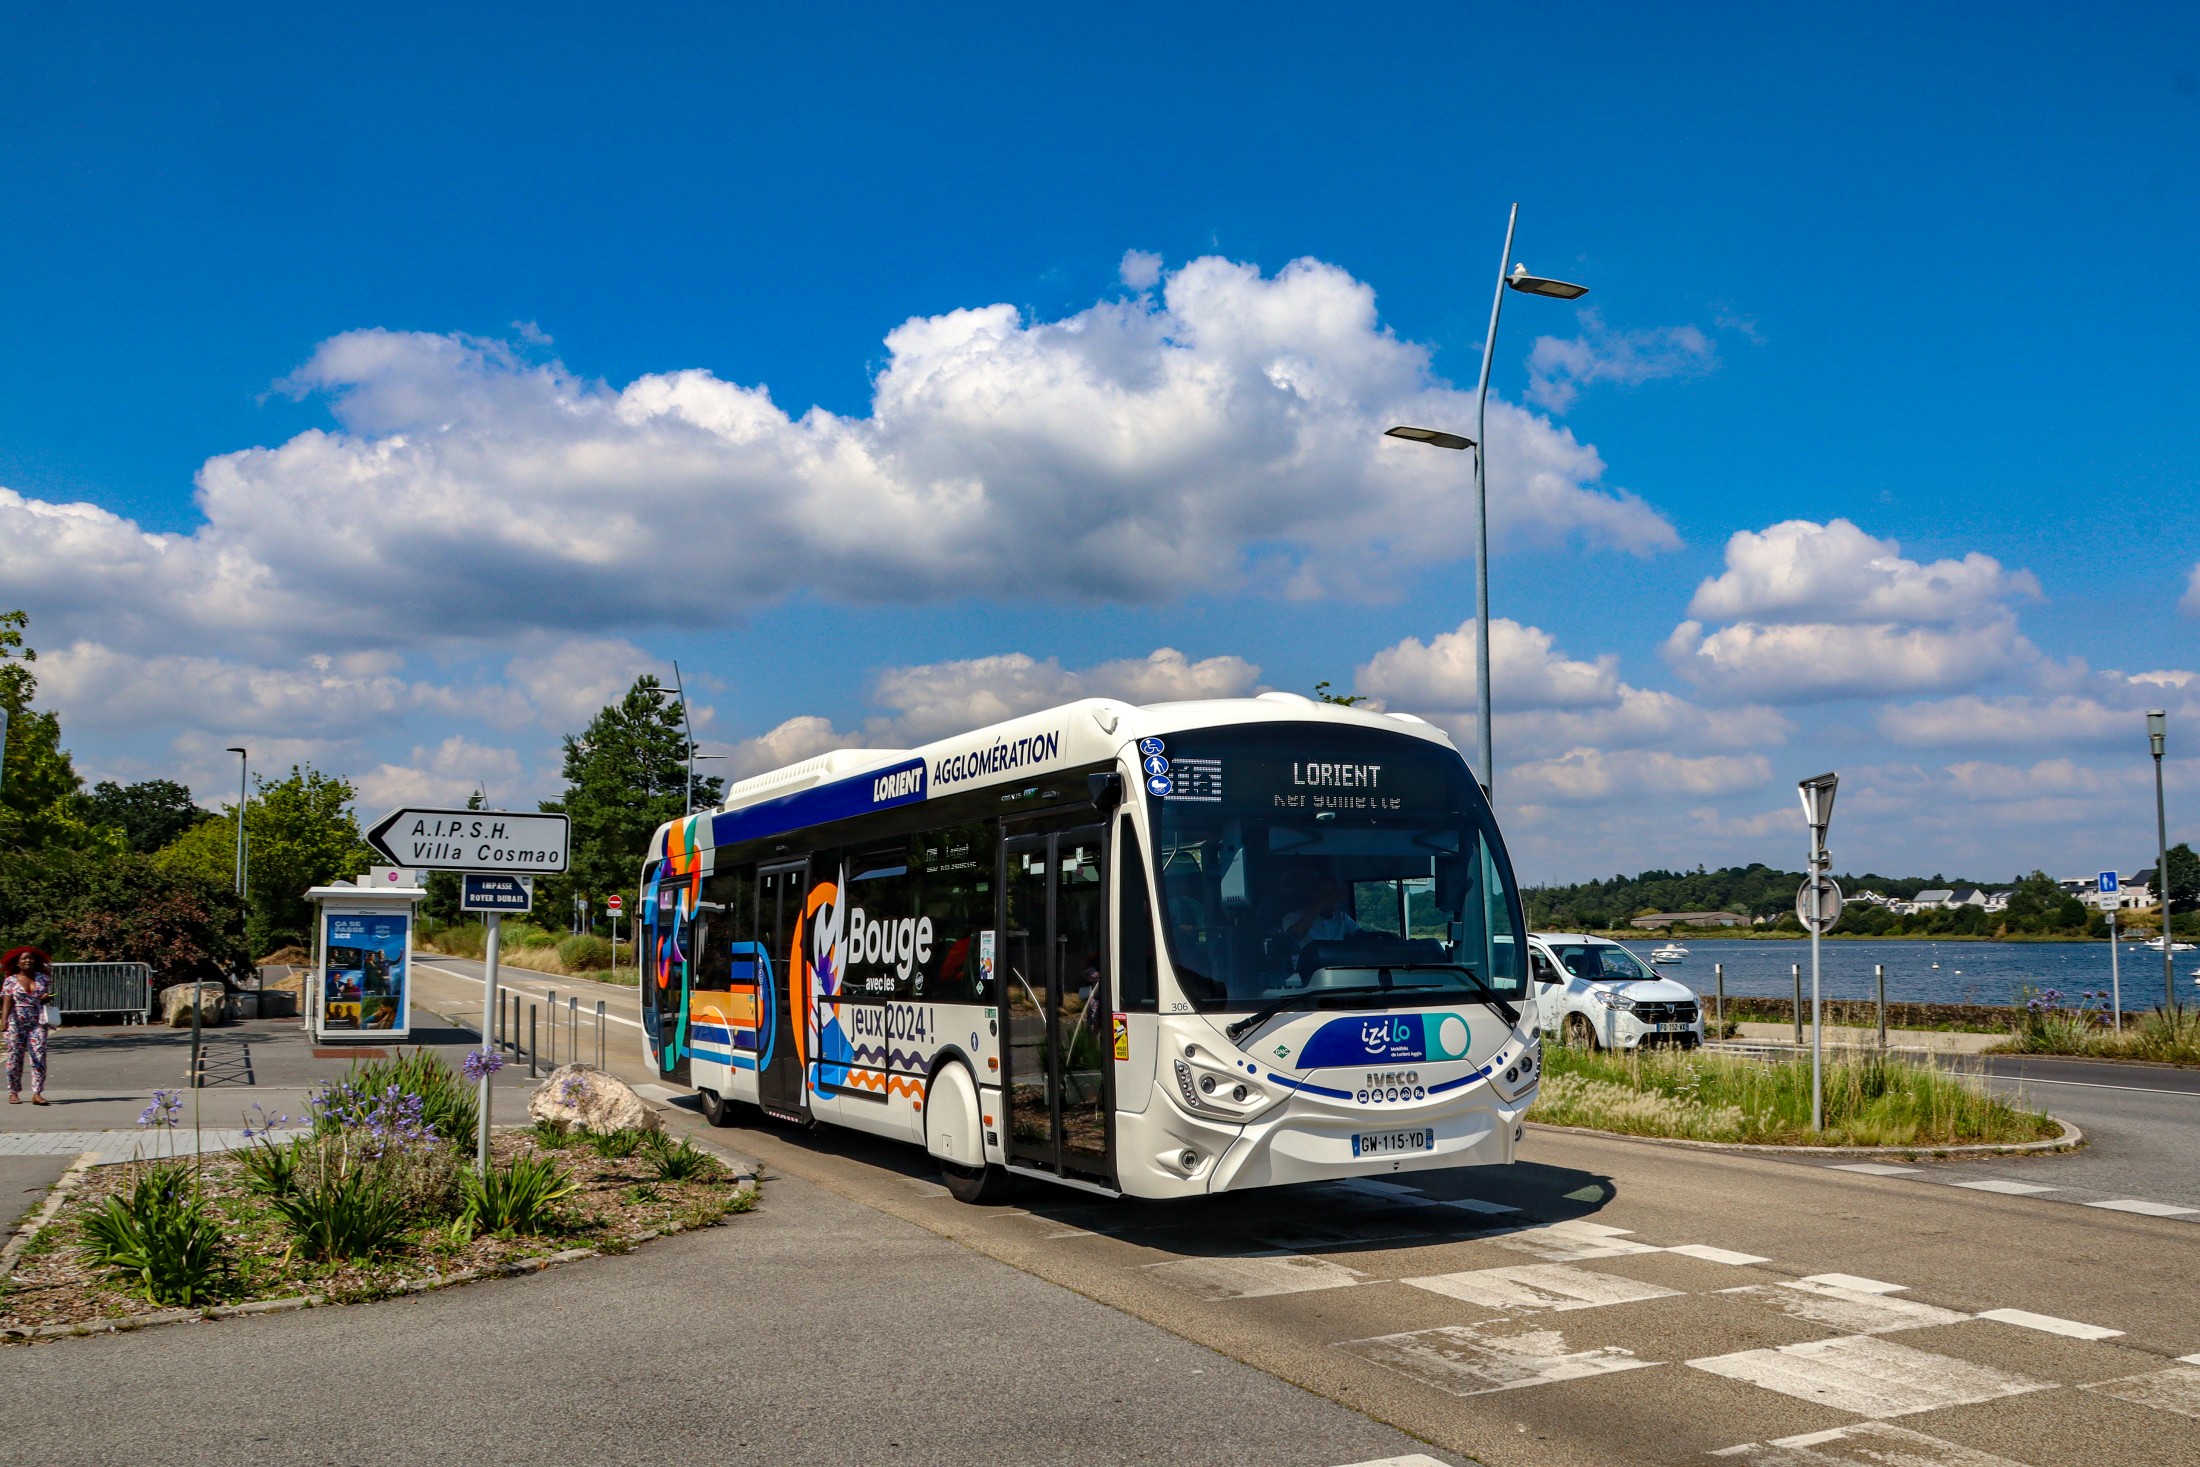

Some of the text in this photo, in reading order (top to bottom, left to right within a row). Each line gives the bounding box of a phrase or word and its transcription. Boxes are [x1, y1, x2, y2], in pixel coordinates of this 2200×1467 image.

[933, 730, 1059, 786] AGGLOMÉRATION
[873, 766, 924, 803] LORIENT
[1293, 762, 1381, 787] LORIENT
[413, 842, 559, 863] Villa Cosmao
[482, 882, 513, 890] IMPASSE
[470, 894, 524, 903] ROYER DUBAIL
[848, 907, 933, 981] Bouge
[865, 973, 895, 992] avec les
[1171, 1002, 1189, 1012] 306
[851, 1003, 883, 1043] jeux
[1366, 1070, 1419, 1088] IVECO
[1362, 1132, 1424, 1152] GW-115-YD
